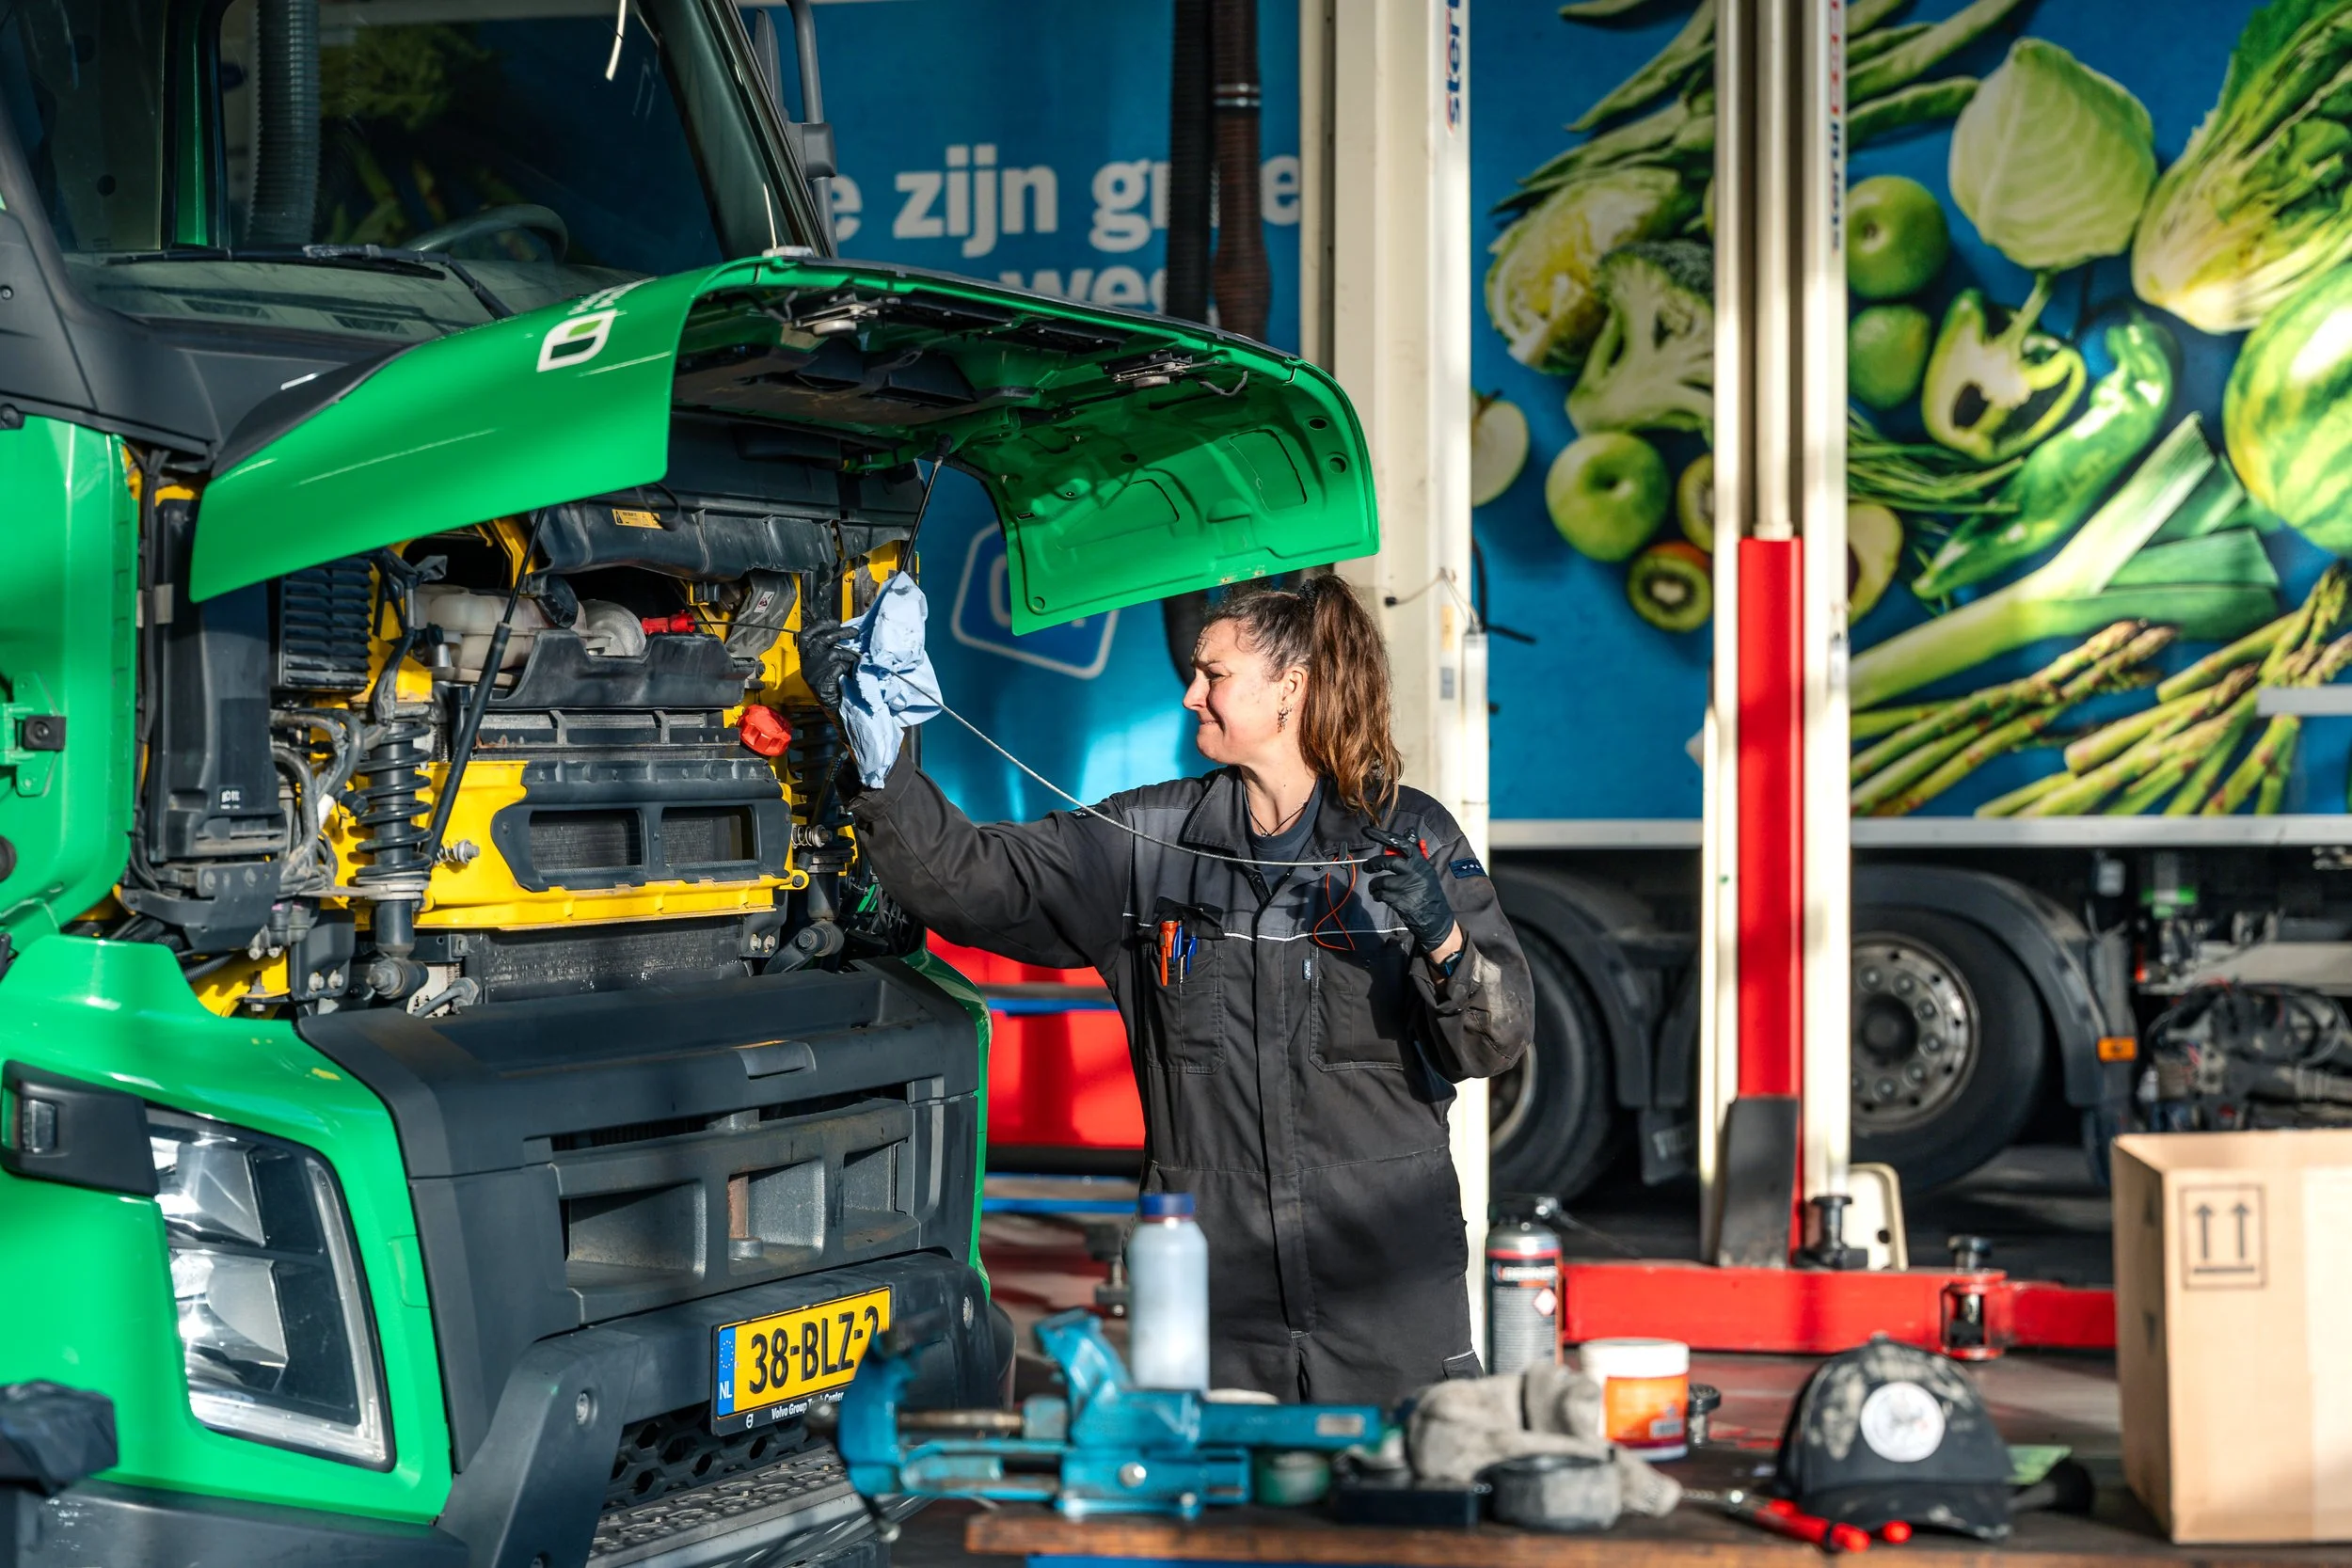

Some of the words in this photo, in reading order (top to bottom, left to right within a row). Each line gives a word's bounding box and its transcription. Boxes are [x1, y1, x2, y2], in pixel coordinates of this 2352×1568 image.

[831, 173, 863, 243] e
[893, 143, 1058, 259] zijn
[719, 1381, 733, 1401] NL
[771, 1405, 788, 1420] Volvo
[788, 1402, 807, 1415] Group
